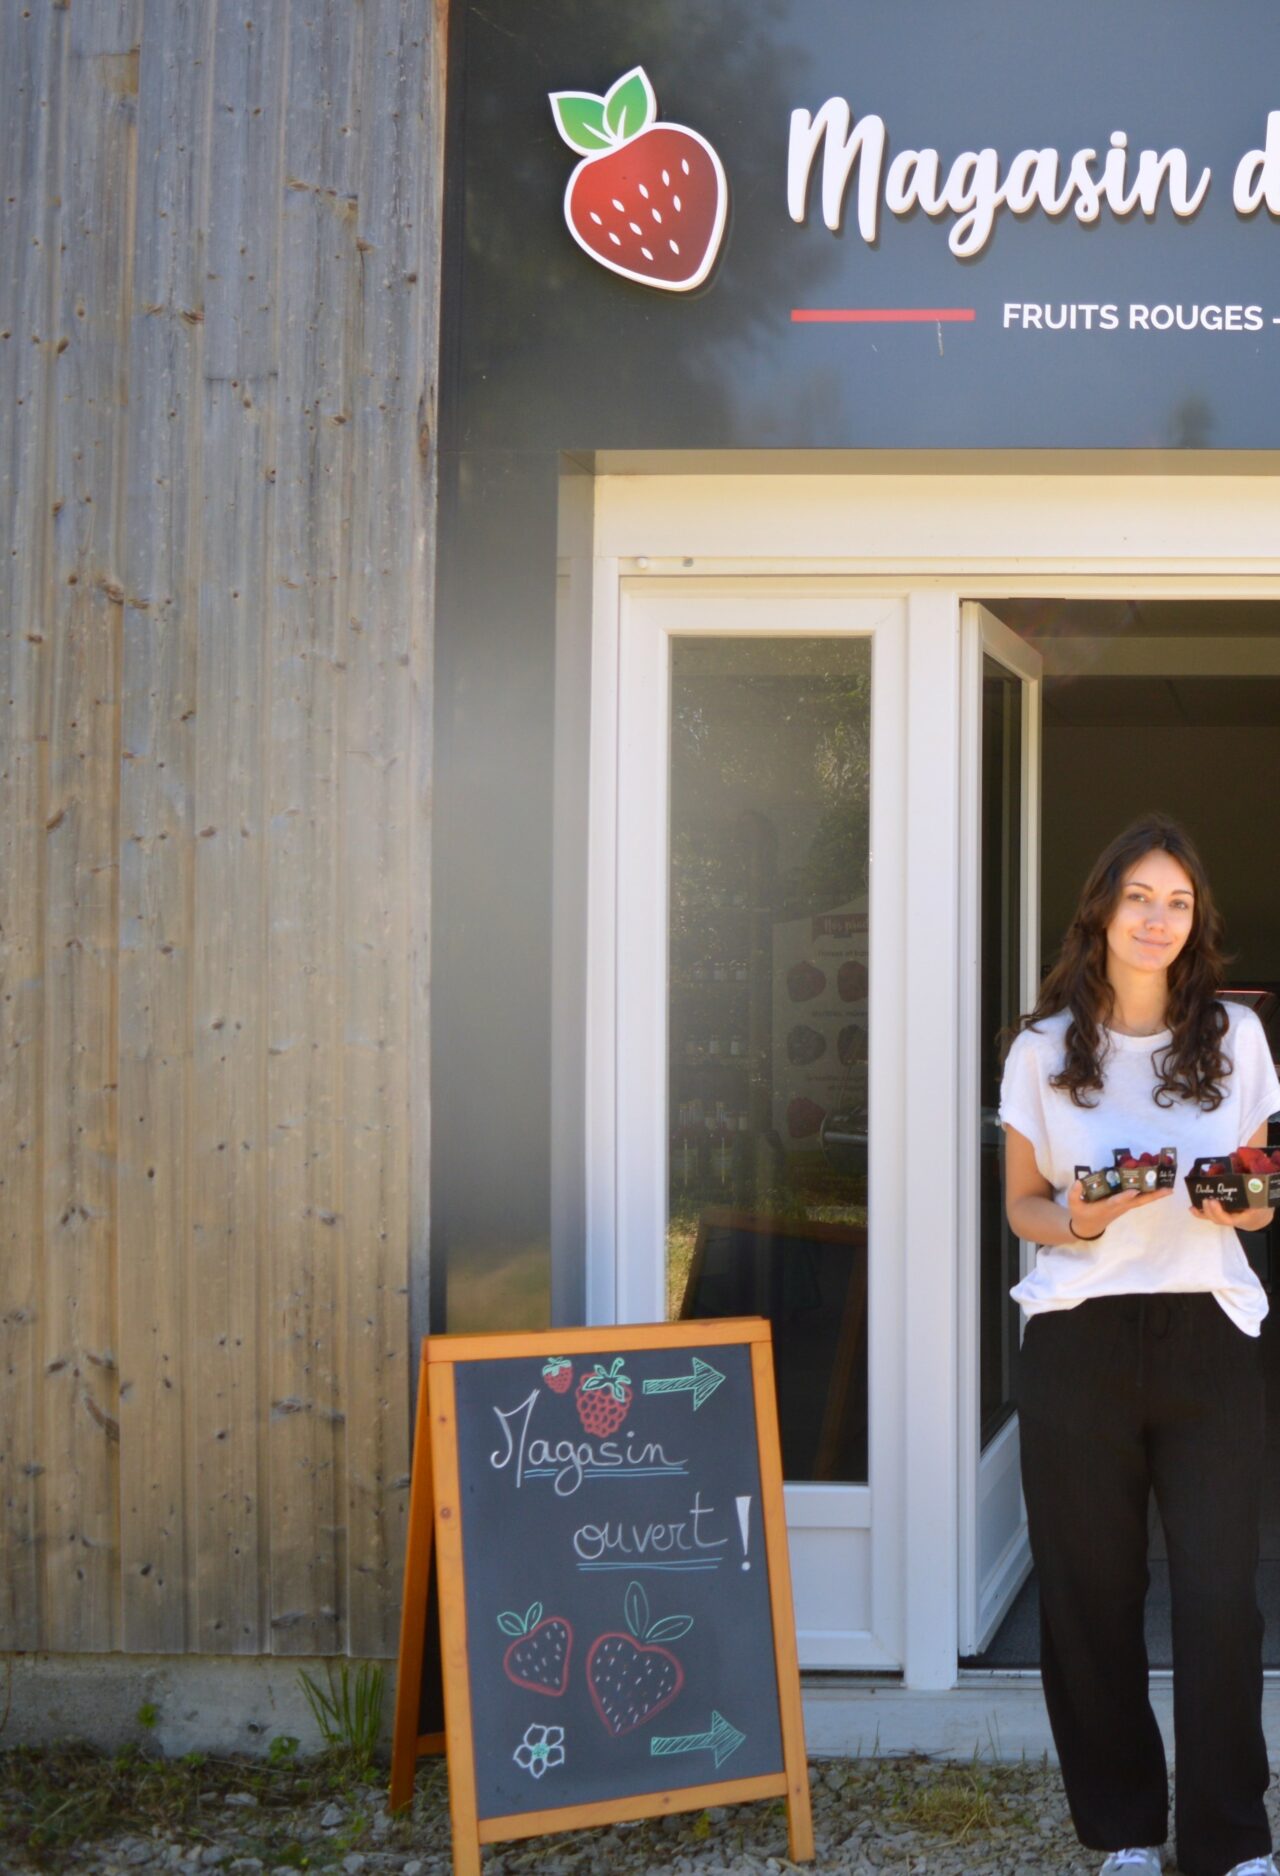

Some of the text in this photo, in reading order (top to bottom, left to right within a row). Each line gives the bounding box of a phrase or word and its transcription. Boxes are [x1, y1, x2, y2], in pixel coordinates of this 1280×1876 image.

[787, 96, 1211, 256] Magasin
[1003, 302, 1120, 330] FRUITS
[1129, 303, 1264, 331] ROUGES
[489, 1388, 689, 1497] Magasin
[573, 1491, 730, 1561] ouvert
